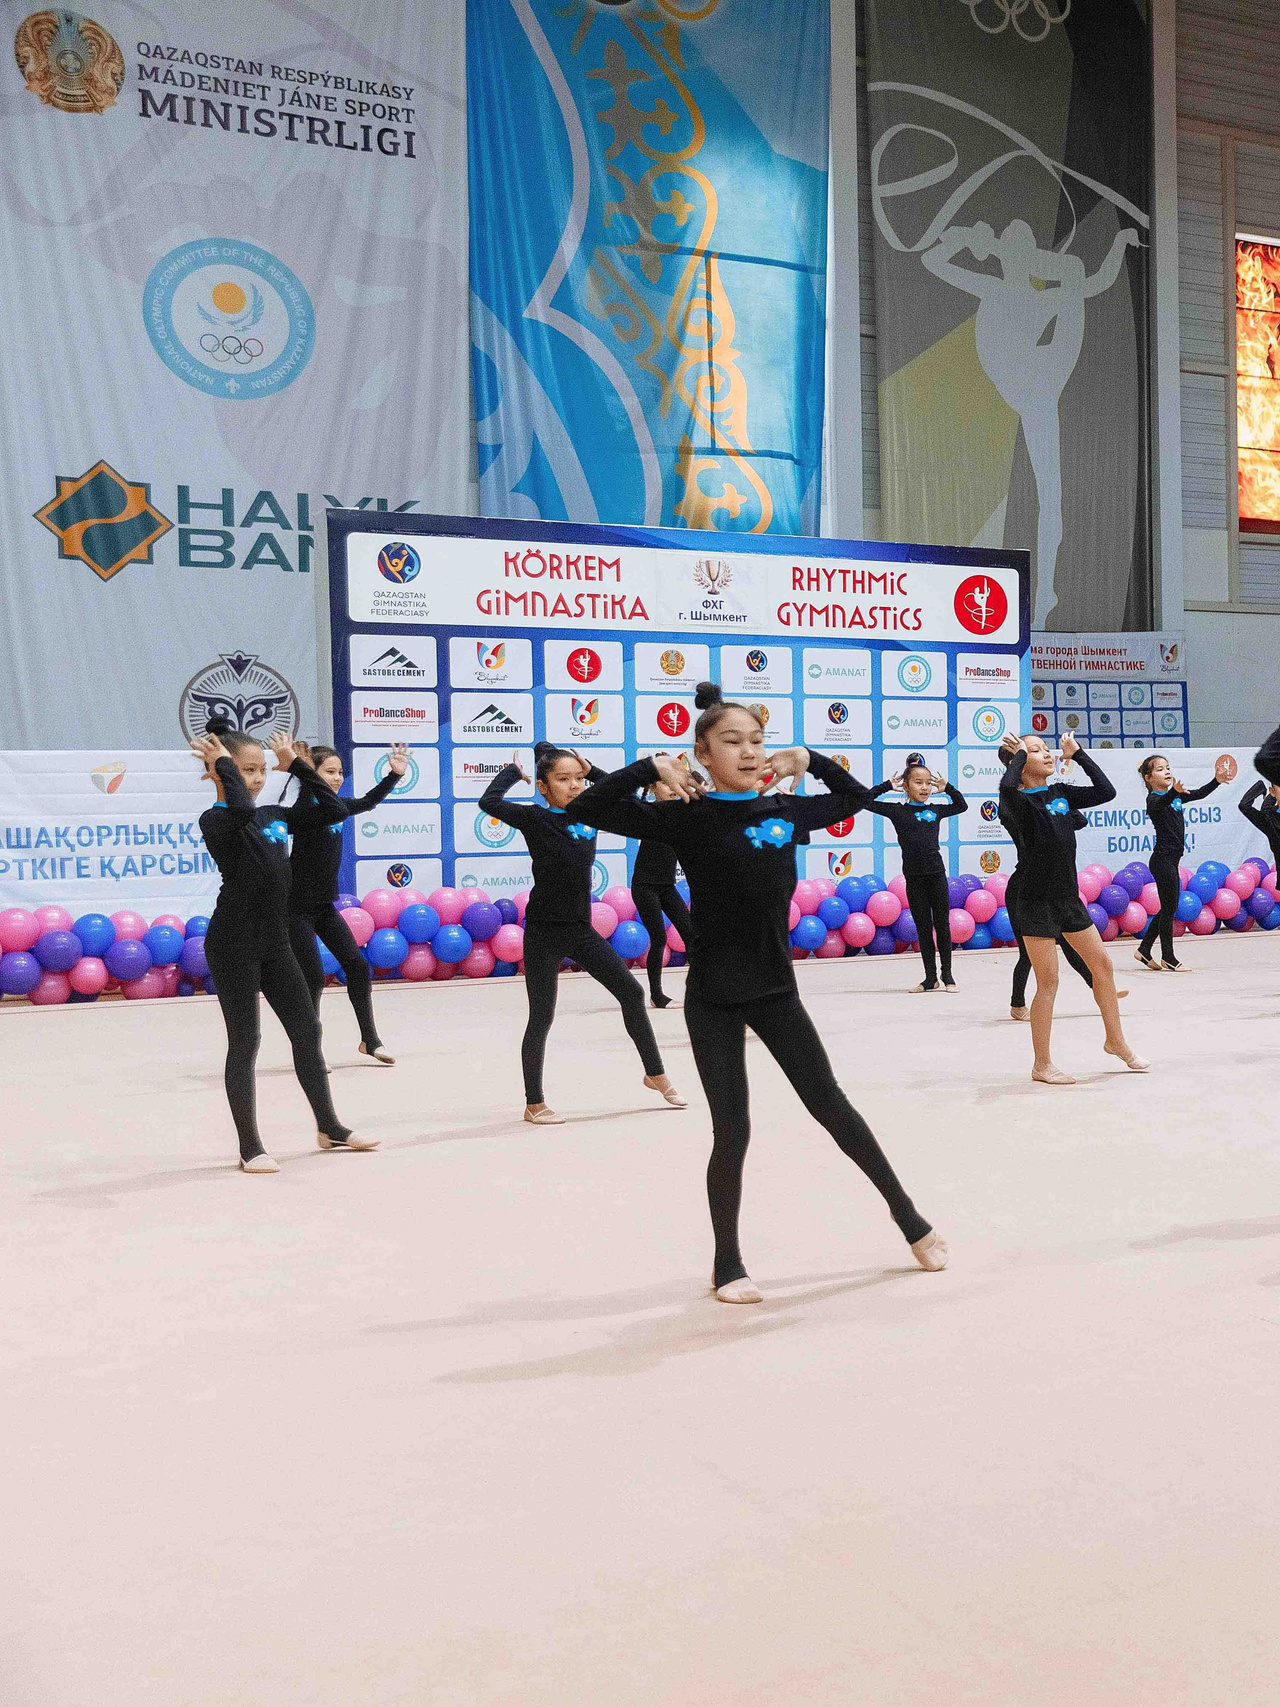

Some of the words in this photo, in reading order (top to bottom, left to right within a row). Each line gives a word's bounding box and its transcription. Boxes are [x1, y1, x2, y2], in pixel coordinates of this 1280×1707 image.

[137, 42, 264, 76] QAZAQSTAN
[271, 65, 415, 101] RESPÝBLIKASY
[138, 63, 271, 101] MÁDENIET
[278, 85, 338, 113] JÁNE
[344, 99, 415, 124] SPORT
[138, 88, 417, 159] MINISTRLIGI
[223, 247, 238, 258] OF
[243, 251, 267, 269] THE
[159, 247, 220, 286] COMMITTEE
[267, 265, 306, 317] REPUBLIC
[152, 286, 168, 340] OLYMPIC
[250, 334, 308, 390] KAZAKHSTAN
[504, 548, 621, 582] KÖRKEM
[373, 590, 426, 599] QAZAQSTAN
[373, 600, 427, 608] GIMNASTIKA
[702, 599, 724, 610] ФХГ
[370, 608, 430, 617] FEDERACIASY
[678, 612, 687, 620] г.
[690, 610, 748, 622] Шымкент
[1030, 646, 1043, 655] ма
[1046, 645, 1078, 657] города
[1081, 645, 1128, 656] Шымкент
[1030, 657, 1077, 670] ТВЕННОЙ
[1079, 660, 1146, 671] ГИМНАСТИКЕ
[825, 667, 867, 677] AMANAT
[965, 667, 1011, 678] ProDanceShop
[363, 707, 426, 720] ProDanceShop
[903, 719, 944, 727] AMANAT
[978, 767, 1005, 776] AMAN
[383, 823, 436, 834] AMANAT
[0, 822, 206, 853] ШАҚОРЛЫҚҚ
[482, 875, 532, 887] AMANAT
